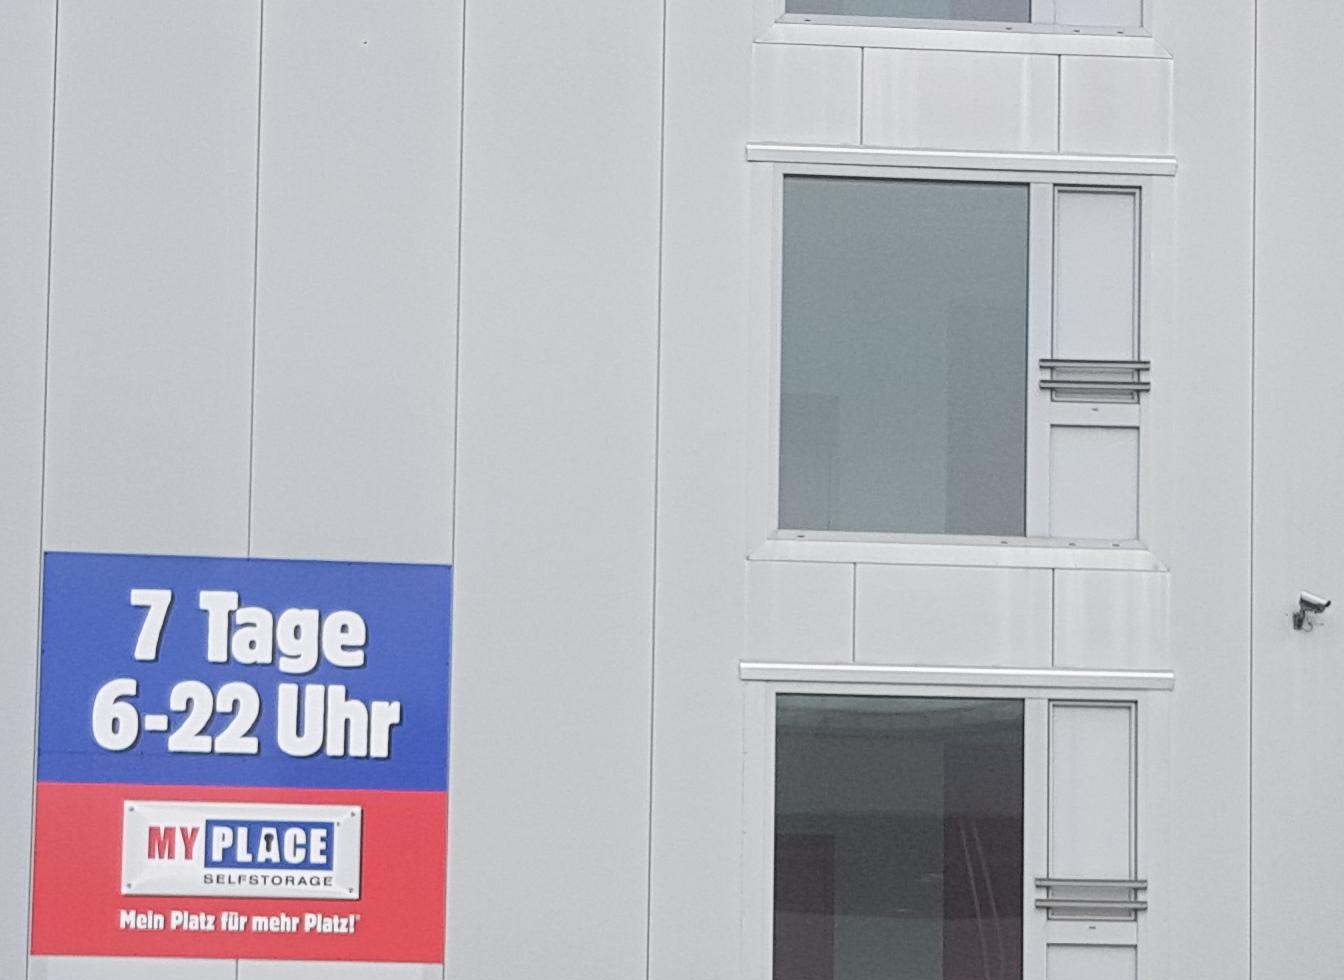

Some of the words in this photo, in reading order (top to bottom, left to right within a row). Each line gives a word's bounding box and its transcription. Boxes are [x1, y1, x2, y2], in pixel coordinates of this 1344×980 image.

[130, 588, 173, 661] 7
[199, 591, 367, 674] Tage
[92, 678, 261, 755] 6-22
[277, 683, 402, 759] Uhr
[147, 826, 200, 861] MY
[211, 826, 329, 865] PLACE
[203, 873, 334, 887] SELFSTORAGE
[119, 909, 165, 930] Mein
[170, 911, 216, 931] Platz
[221, 911, 248, 931] für
[252, 914, 300, 932] mehr
